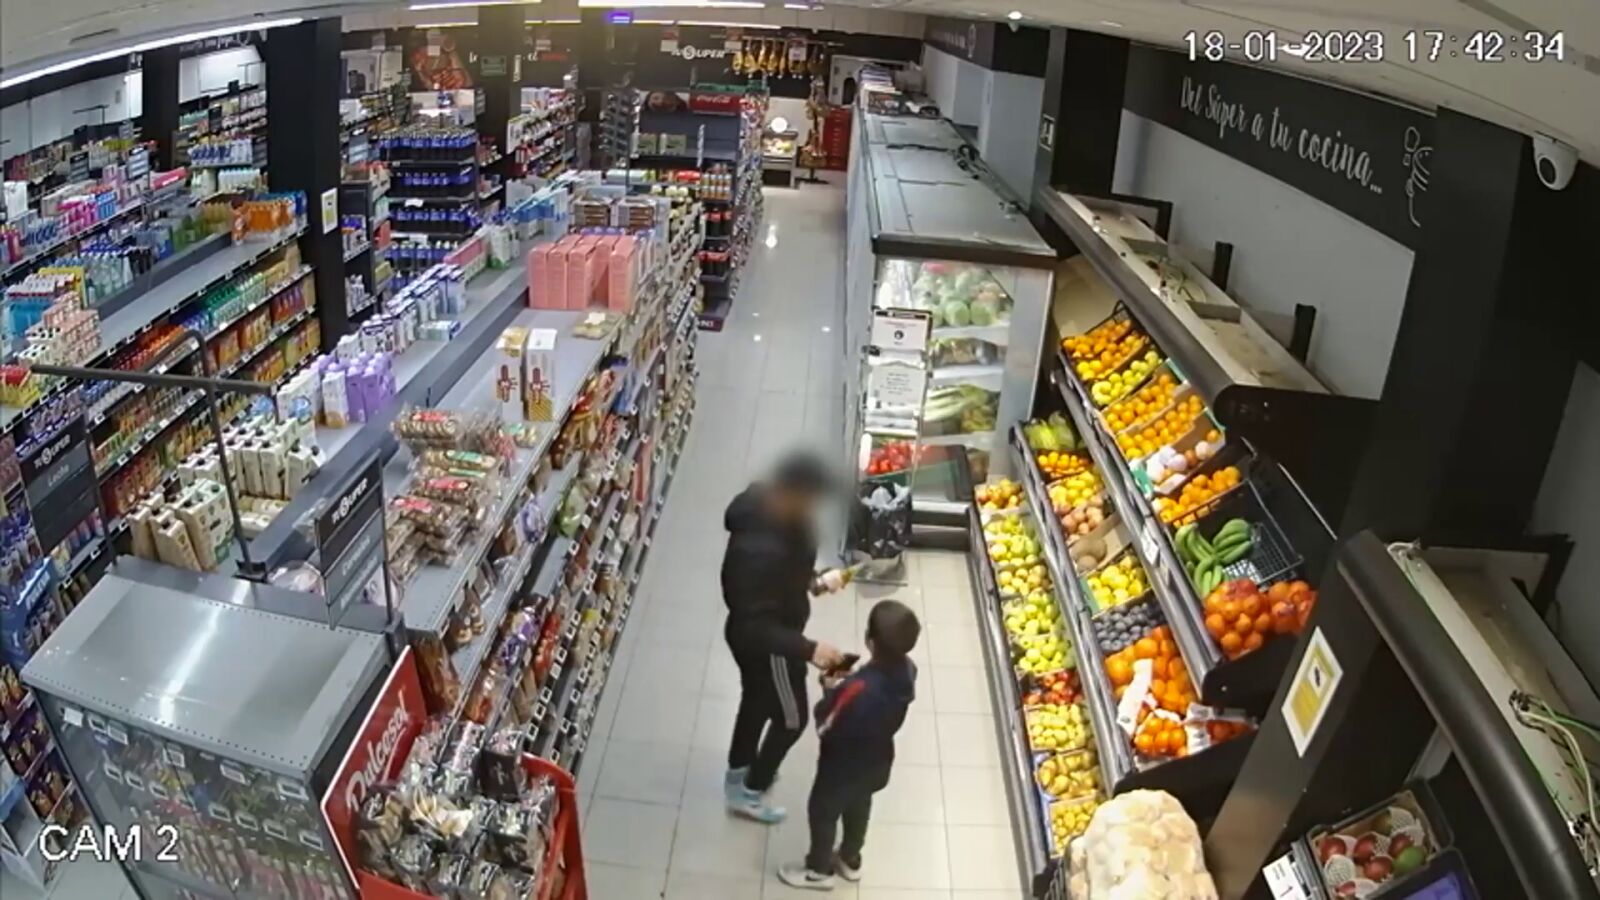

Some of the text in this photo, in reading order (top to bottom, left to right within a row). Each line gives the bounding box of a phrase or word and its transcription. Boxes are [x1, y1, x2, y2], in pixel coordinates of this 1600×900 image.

[1180, 76, 1203, 115] Del
[1251, 113, 1264, 141] a
[1270, 106, 1293, 151] tu
[340, 478, 368, 518] SUPER
[345, 690, 410, 813] Dulcesol
